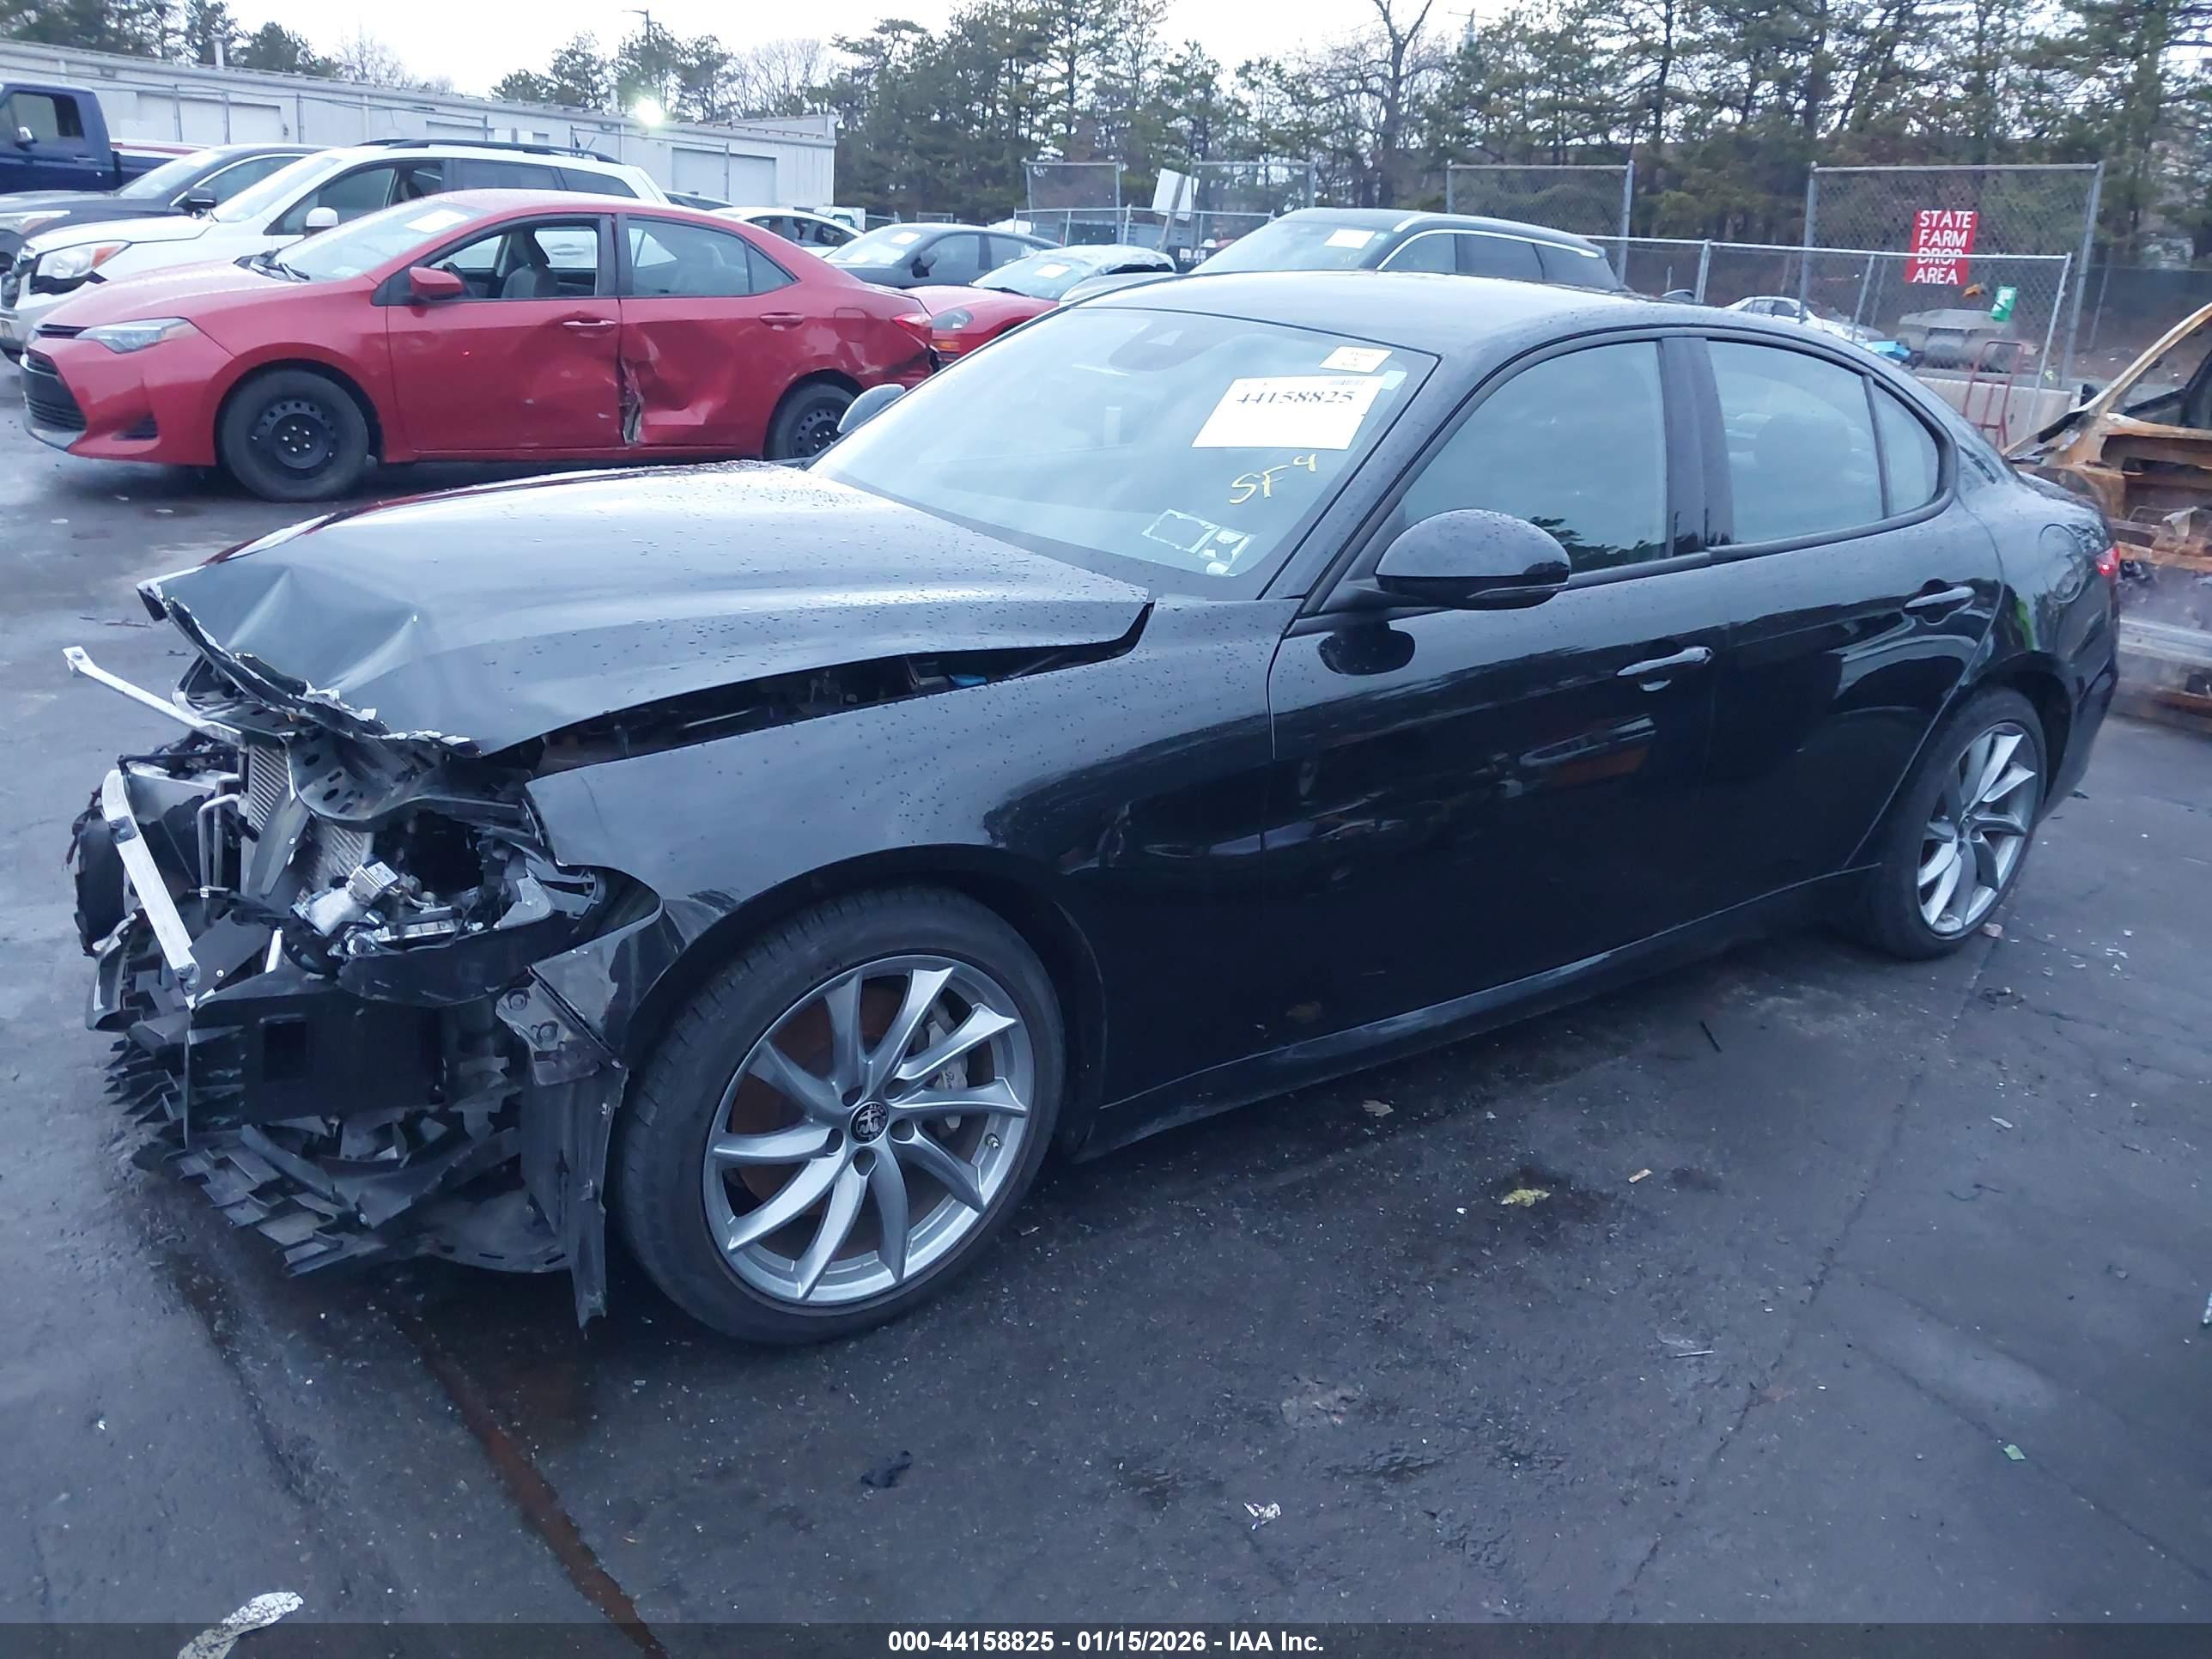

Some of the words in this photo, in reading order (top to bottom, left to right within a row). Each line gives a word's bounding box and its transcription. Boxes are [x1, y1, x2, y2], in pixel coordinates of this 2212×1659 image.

[1918, 210, 1974, 229] STATE
[1917, 228, 1968, 248] FARM
[1916, 246, 1964, 266] DROP
[1911, 267, 1960, 285] AREA
[1236, 390, 1357, 404] 44158825
